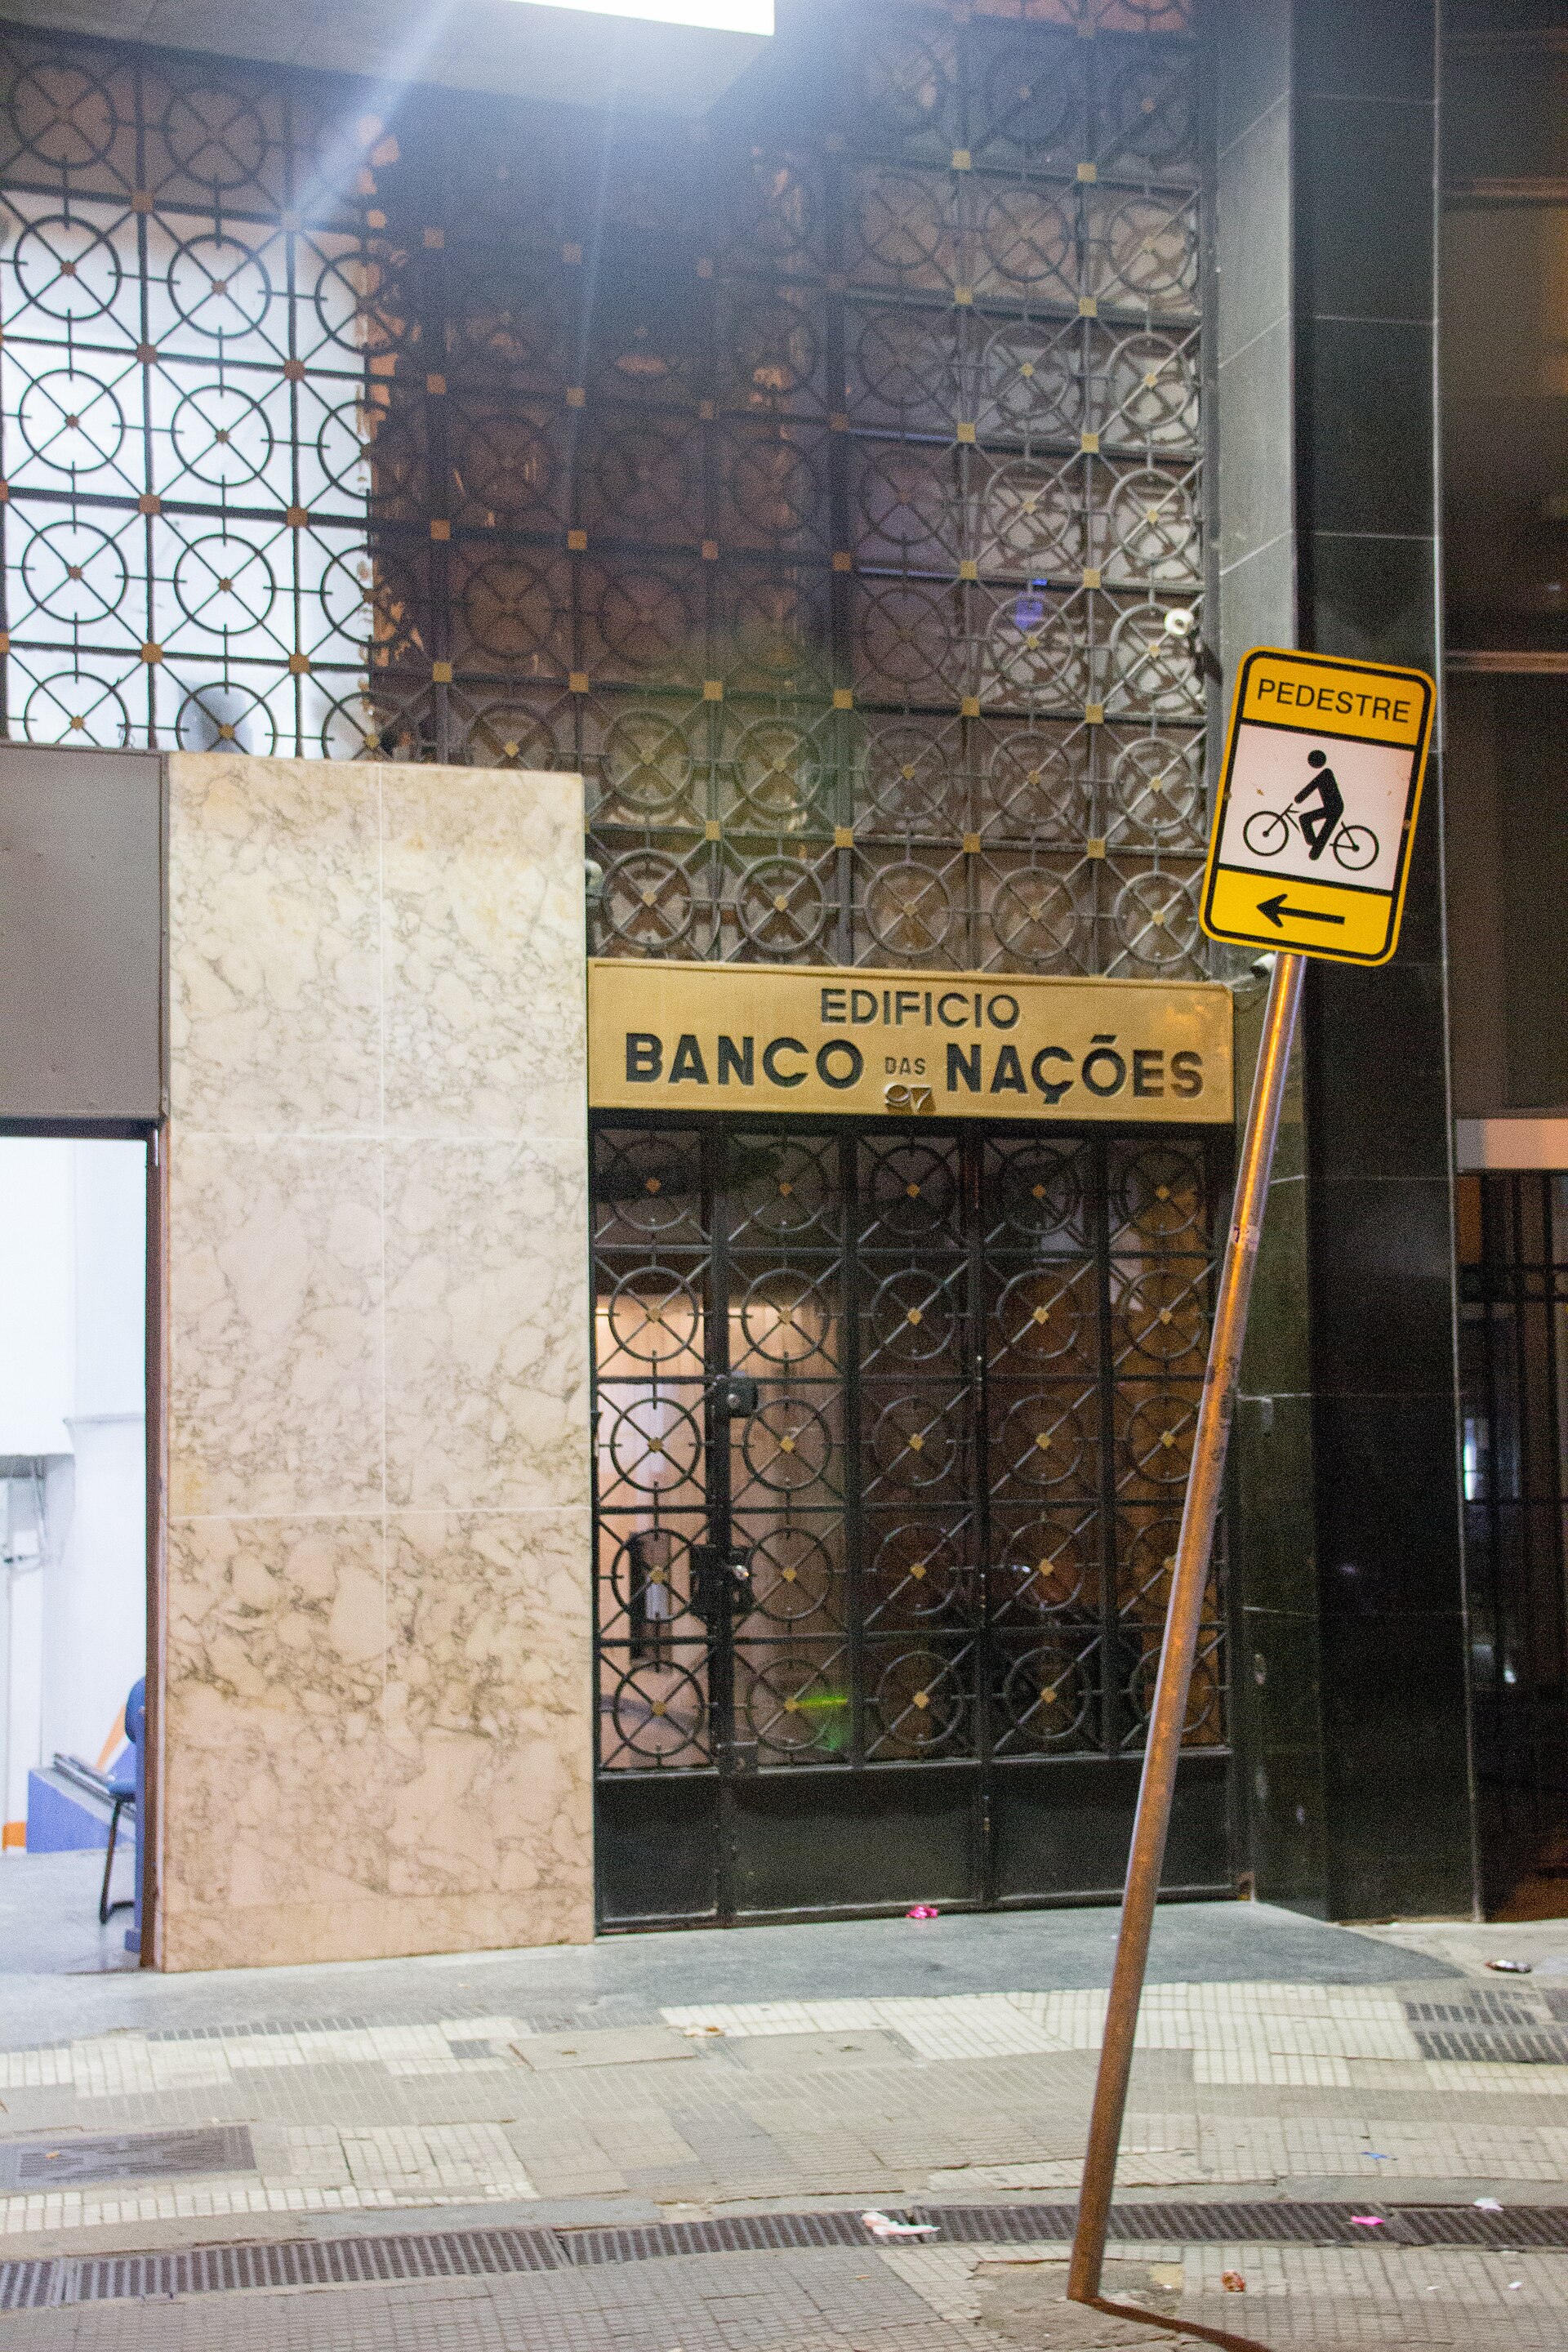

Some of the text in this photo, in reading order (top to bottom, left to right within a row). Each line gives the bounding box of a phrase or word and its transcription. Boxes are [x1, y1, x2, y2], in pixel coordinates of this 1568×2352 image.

[1256, 678, 1411, 724] PEDESTRE
[820, 987, 1020, 1031] EDIFICIO
[626, 1032, 1205, 1105] BANCO DAS NAÇÕES
